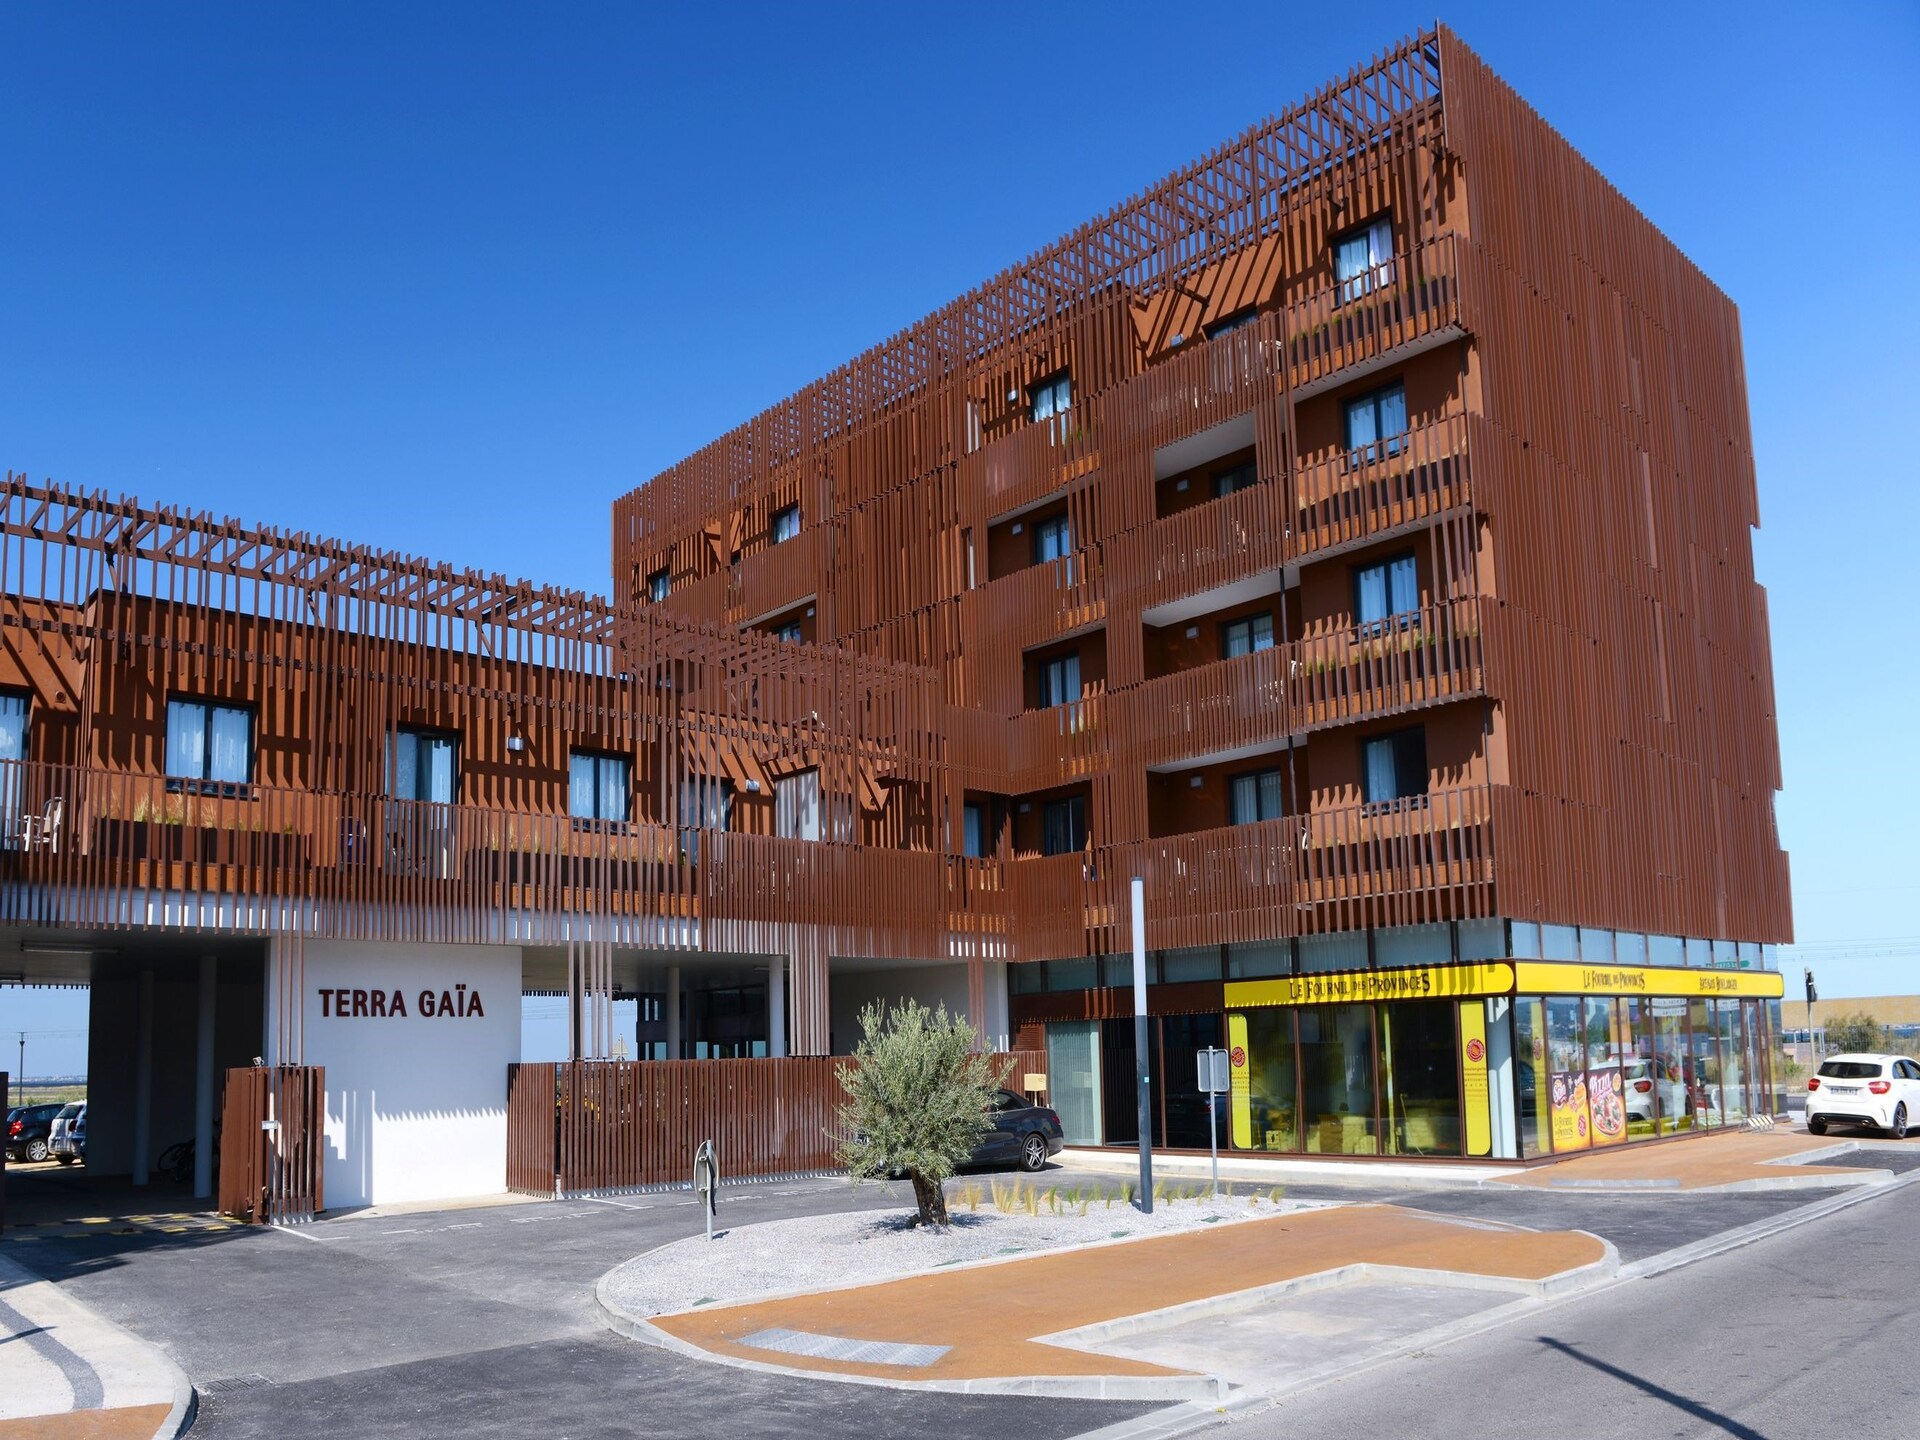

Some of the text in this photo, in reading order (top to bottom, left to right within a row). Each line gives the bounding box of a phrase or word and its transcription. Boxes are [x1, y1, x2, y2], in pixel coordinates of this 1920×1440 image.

[318, 984, 484, 1017] TERRA GAÏA
[1289, 982, 1303, 999] LE
[1306, 980, 1350, 998] FOURNIL
[1368, 973, 1430, 996] PROVINCES
